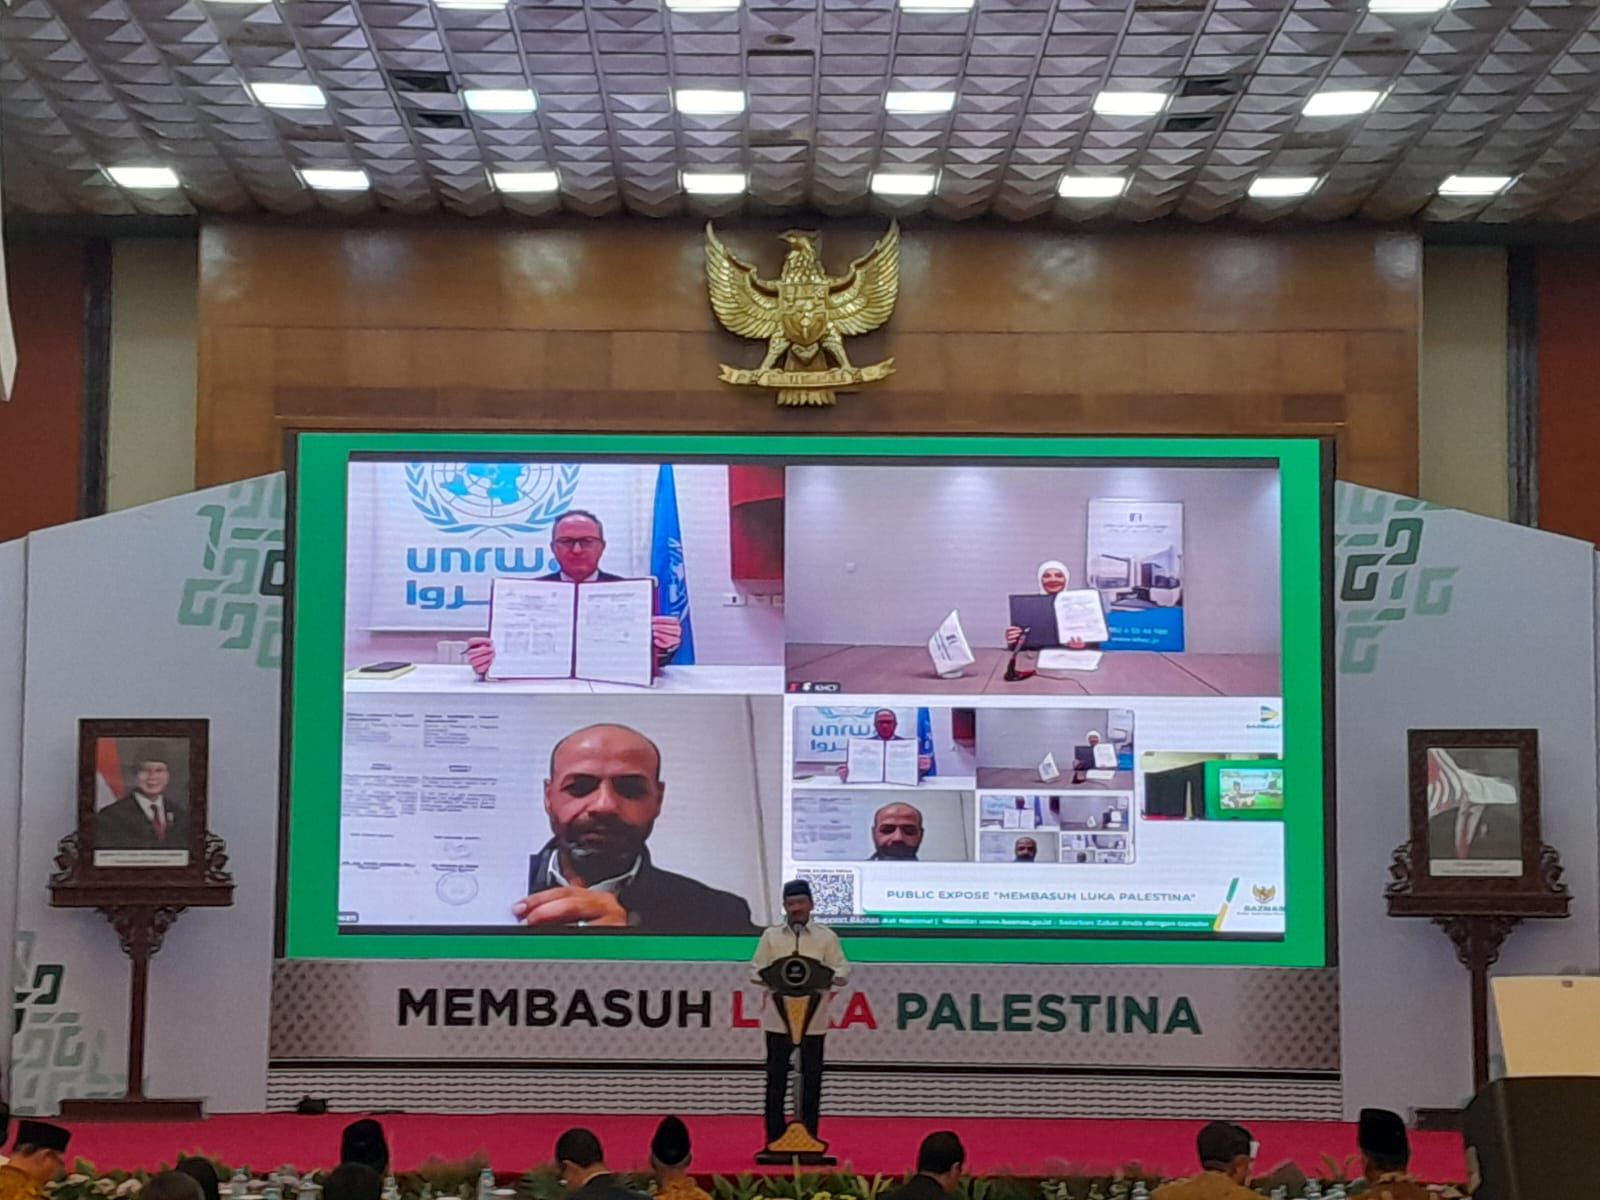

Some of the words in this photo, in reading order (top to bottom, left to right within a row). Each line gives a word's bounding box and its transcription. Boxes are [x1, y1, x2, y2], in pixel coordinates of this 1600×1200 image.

[406, 580, 490, 609] روا
[811, 724, 876, 737] unrw
[886, 889, 935, 900] PUBLIC
[938, 890, 990, 900] EXPOSE
[1080, 891, 1116, 902] LUKA
[398, 987, 712, 1029] MEMBASUH
[732, 990, 877, 1031] LA
[896, 992, 1203, 1035] PALESTINA
